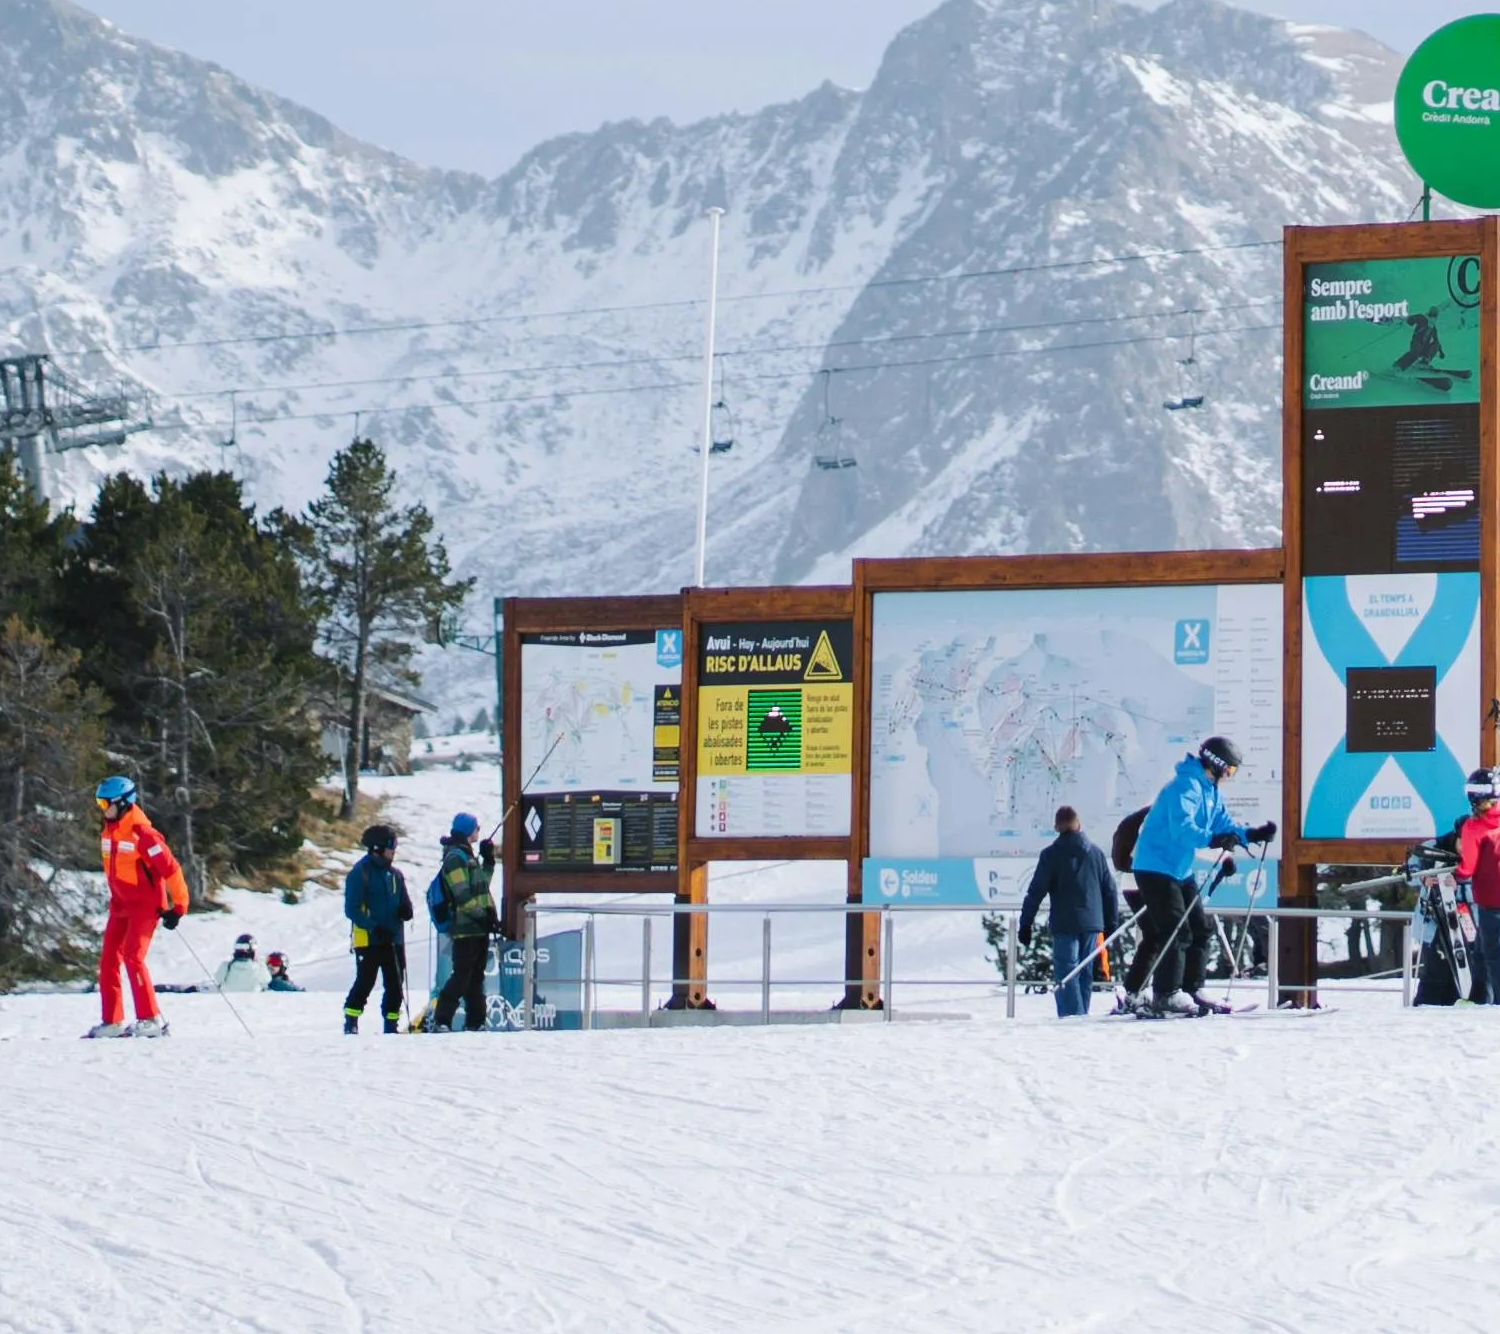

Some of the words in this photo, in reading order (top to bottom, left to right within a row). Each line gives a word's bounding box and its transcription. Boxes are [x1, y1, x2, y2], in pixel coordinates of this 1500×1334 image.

[1311, 278, 1372, 299] Sempre
[1311, 301, 1346, 321] amb
[706, 635, 731, 650] Avui
[739, 638, 755, 651] Hoy
[706, 655, 736, 673] RISC
[738, 653, 801, 672] D'ALLAUS
[716, 698, 733, 711] Fora
[734, 698, 744, 711] de
[708, 717, 720, 730] les
[721, 716, 743, 732] pistes
[703, 733, 743, 748] abalisades
[715, 753, 742, 766] obertes
[901, 869, 938, 885] Soldeu
